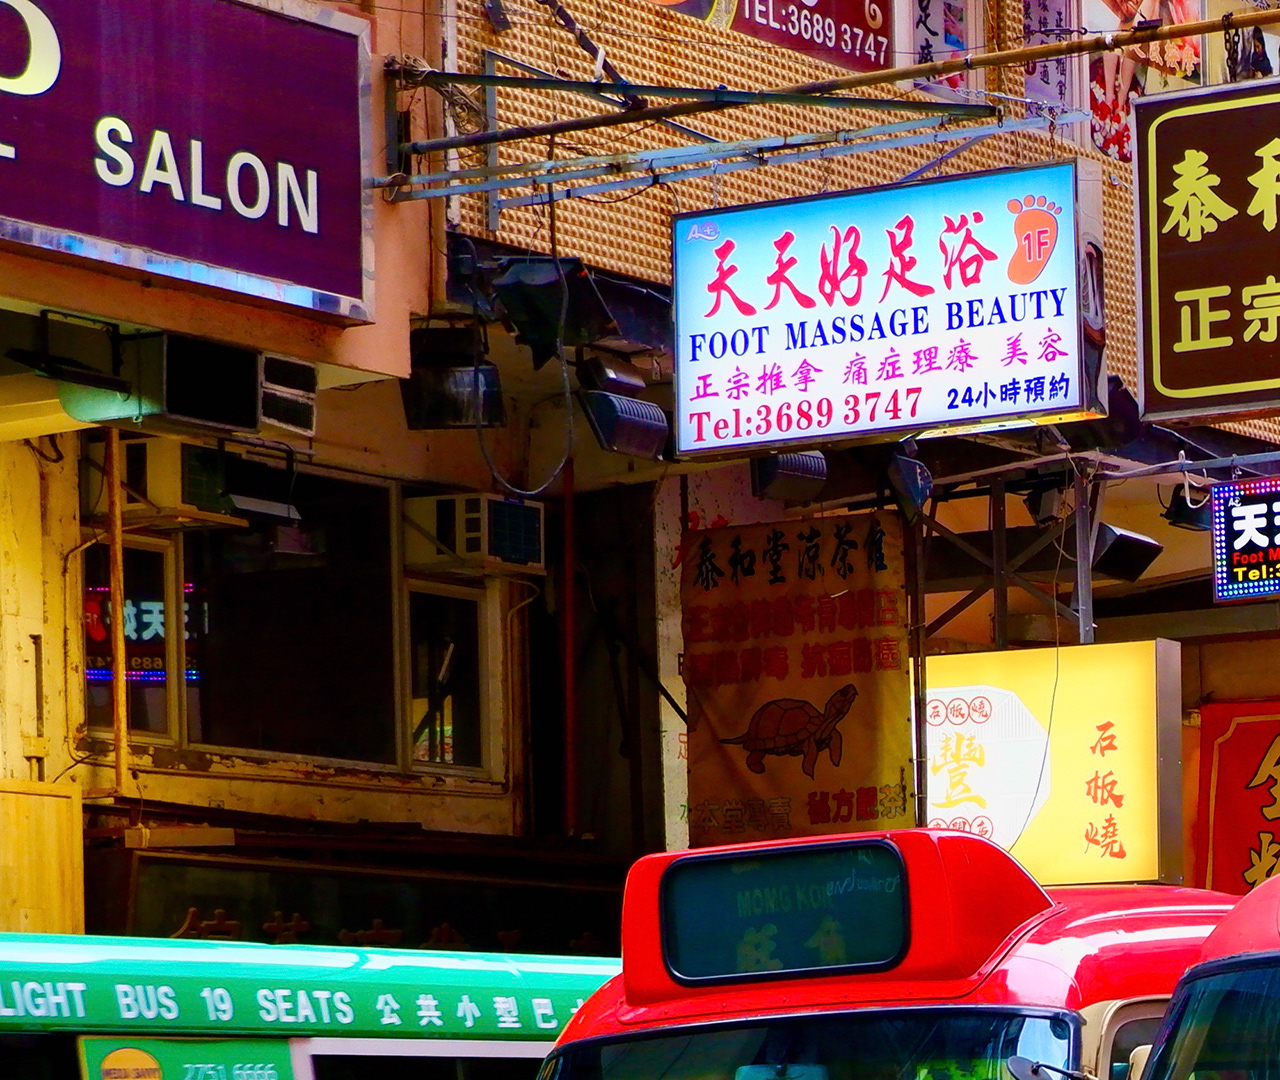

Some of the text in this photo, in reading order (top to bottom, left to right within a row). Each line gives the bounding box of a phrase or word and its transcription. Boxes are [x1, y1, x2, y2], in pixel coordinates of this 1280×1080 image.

[840, 23, 889, 66] 3747
[94, 116, 319, 235] SALON
[703, 210, 999, 319] 天天好足浴
[1022, 228, 1051, 263] 1F
[689, 287, 1068, 362] FOOT MASSAGE BEAUTY
[689, 326, 1069, 402] 正宗推拿 痛症理療 美容
[689, 387, 923, 443] Tel:3689 3747
[947, 371, 1070, 410] 24小時預約
[1232, 550, 1265, 566] Foot
[1084, 720, 1128, 860] 石板燒
[114, 983, 181, 1022] BUS
[199, 985, 235, 1023] 19
[257, 987, 356, 1026] SEATS
[374, 992, 586, 1031] 公共小型巴
